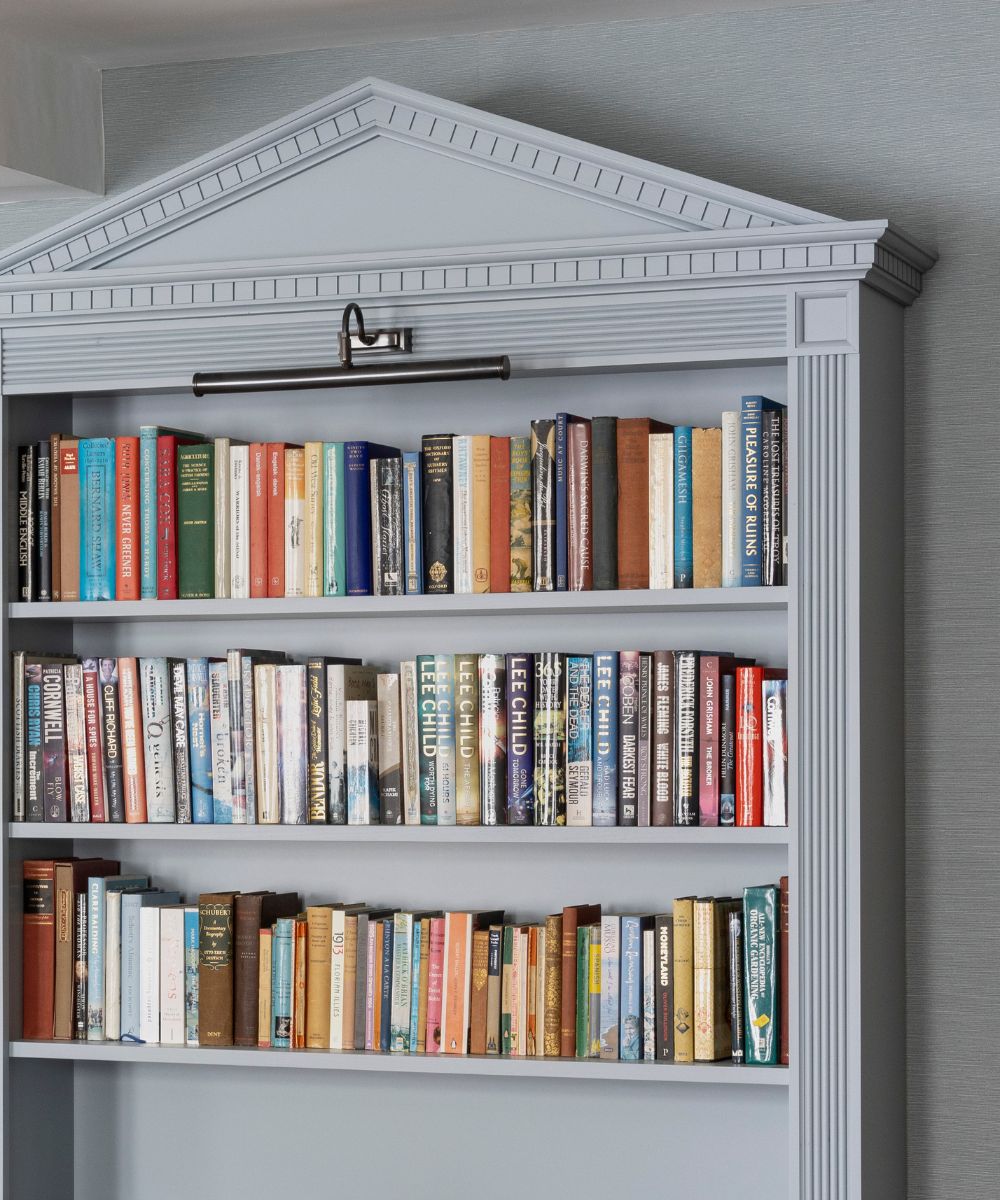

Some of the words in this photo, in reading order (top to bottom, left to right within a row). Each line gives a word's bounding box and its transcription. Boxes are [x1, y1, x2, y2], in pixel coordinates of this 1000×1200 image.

[727, 421, 736, 447] JOHN
[771, 416, 780, 437] THE
[122, 443, 131, 469] RUTH
[557, 444, 563, 455] AT
[580, 439, 590, 491] DARWIN'S
[746, 427, 757, 491] PLEASURE
[771, 440, 780, 463] LOST
[38, 457, 46, 477] ISAIAH
[677, 435, 687, 503] GILGAMESH
[728, 448, 736, 491] GRISHAM
[38, 478, 46, 500] BERLIN
[91, 471, 101, 533] BERNARD
[121, 473, 131, 500] JONES
[746, 494, 757, 511] OF
[771, 465, 780, 517] TREASURES
[19, 491, 27, 526] MIDDLE
[122, 504, 131, 534] NEVER
[580, 494, 590, 535] SACRED
[746, 515, 757, 556] RUINS
[771, 518, 780, 533] OF
[19, 528, 27, 567] ENGLISH
[91, 536, 101, 572] SHAW
[122, 537, 131, 577] GREENER
[580, 537, 590, 570] CAUSE
[771, 534, 780, 564] TROY
[173, 667, 185, 693] DEVIL
[421, 661, 437, 695] LEE
[436, 661, 450, 695] LEE
[459, 661, 474, 695] LEE
[511, 658, 527, 693] LEE
[569, 662, 578, 685] AND
[597, 655, 612, 690] LEE
[656, 662, 669, 692] JAMES
[680, 657, 695, 707] FREDERICK
[28, 684, 40, 717] CHRIS
[43, 674, 62, 744] CORNWELL
[86, 683, 94, 709] HOUSE
[104, 684, 115, 713] CLIFF
[174, 696, 185, 718] MAY
[211, 672, 221, 720] SLAUGHTER
[569, 686, 578, 708] THE
[622, 675, 634, 725] COBEN
[641, 705, 648, 714] OF
[88, 710, 96, 725] FOR
[421, 699, 437, 757] CHILD
[437, 699, 451, 757] CHILD
[459, 699, 474, 758] CHILD
[511, 697, 527, 756] CHILD
[569, 709, 578, 739] DEAD
[597, 695, 612, 756] CHILD
[656, 695, 669, 735] FLEMING
[680, 710, 695, 753] FORSYTH
[28, 718, 40, 746] RYAN
[89, 727, 97, 748] SPIES
[106, 714, 118, 759] RICHARD
[175, 720, 186, 748] CARE
[198, 713, 207, 758] Hornet's
[73, 754, 84, 785] WORST
[216, 733, 229, 784] broken
[622, 734, 635, 774] DARKEST
[656, 742, 669, 770] WHITE
[29, 751, 38, 801] Increment
[310, 761, 326, 820] BENDOR
[519, 768, 527, 789] GONE
[568, 766, 578, 805] SEYMOUR
[579, 766, 589, 797] GERALD
[622, 777, 635, 799] FEAR
[656, 771, 669, 802] BLOOD
[75, 785, 86, 805] CASE
[91, 883, 99, 912] CLARE
[91, 914, 99, 954] BALDING
[127, 915, 135, 943] Schott's
[603, 923, 611, 953] MUSSO
[750, 909, 758, 948] ORGANIC
[758, 911, 766, 941] ALL-NEW
[332, 931, 344, 955] 1913
[660, 926, 668, 986] MONEYLAND
[127, 945, 135, 978] Almanac
[384, 965, 390, 973] LA
[750, 949, 759, 1000] GARDENING
[758, 943, 766, 992] ENCYCLOPEDIA
[333, 964, 341, 994] FLORIAN
